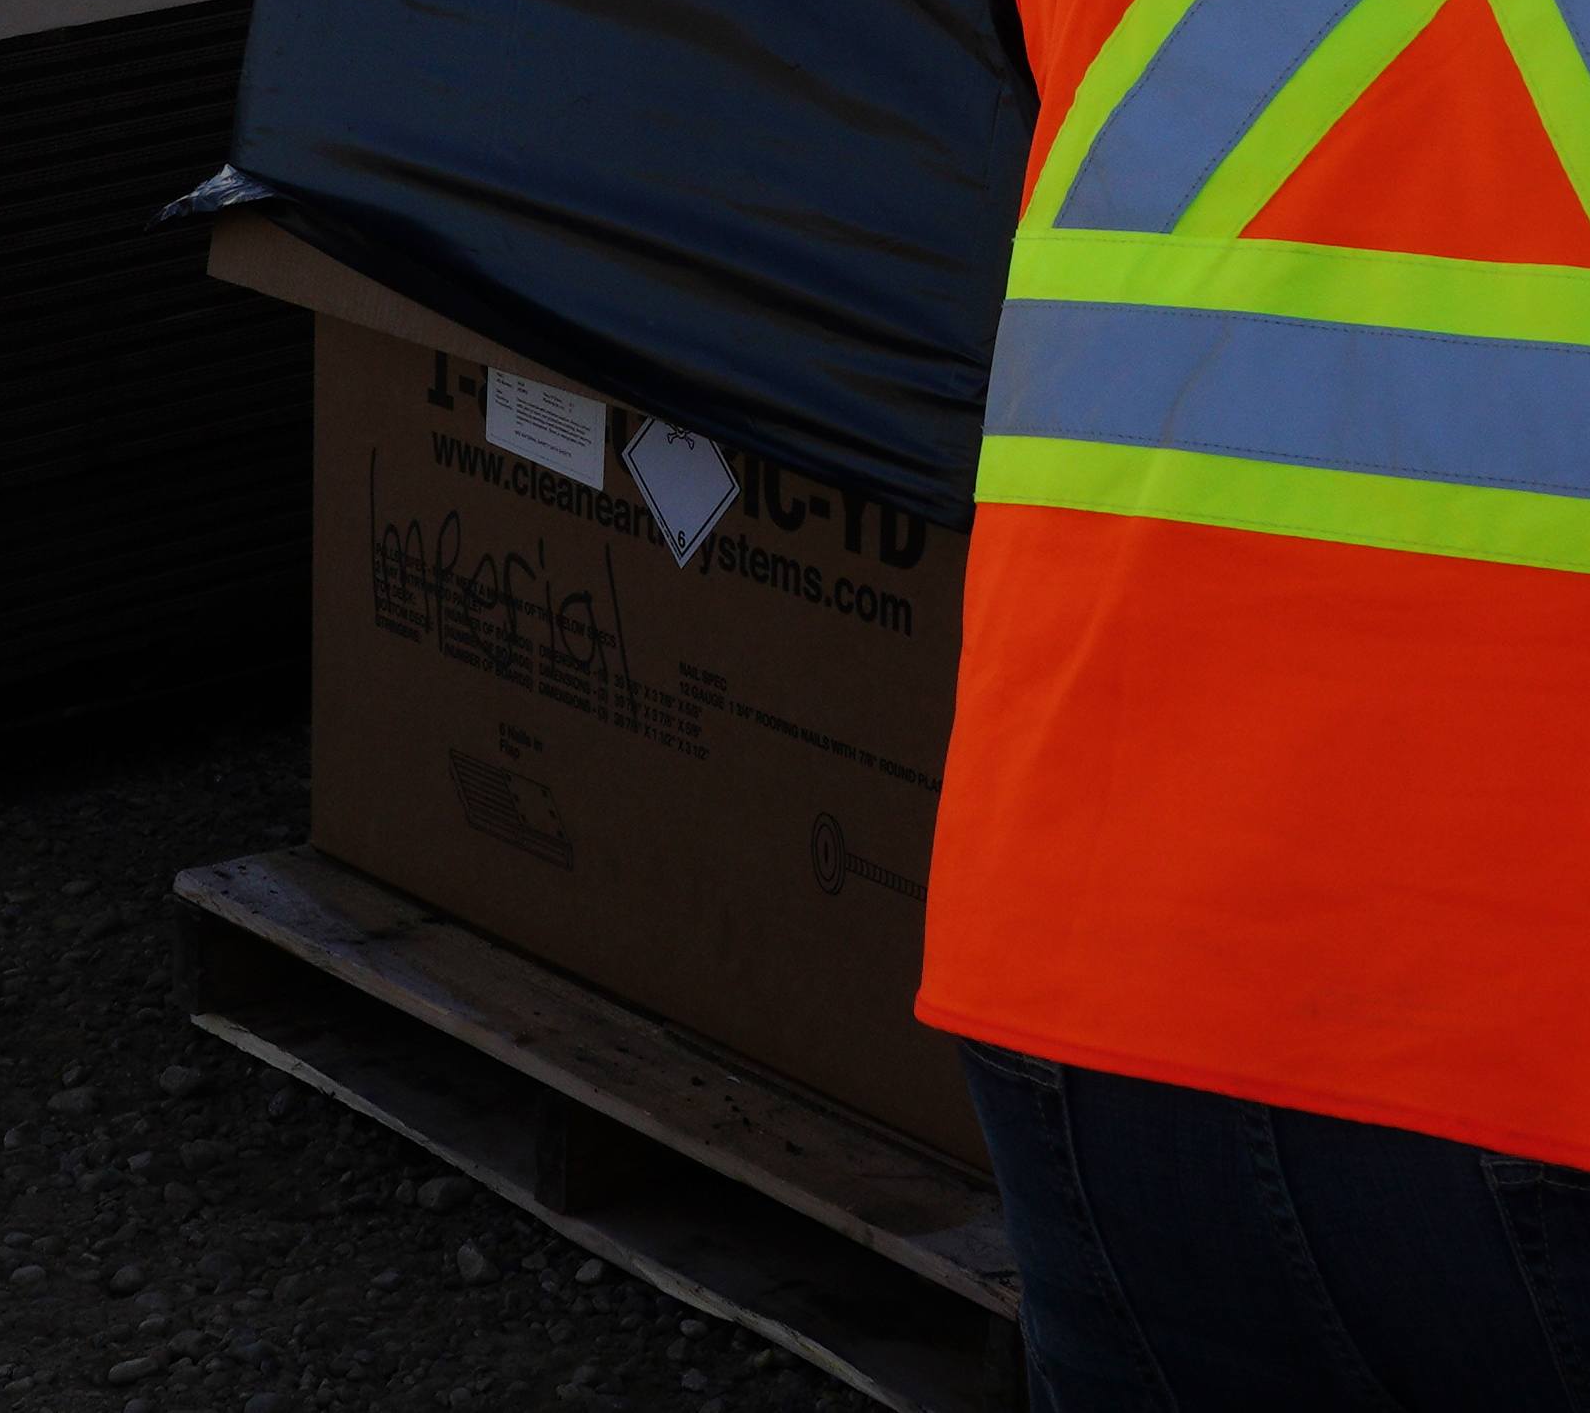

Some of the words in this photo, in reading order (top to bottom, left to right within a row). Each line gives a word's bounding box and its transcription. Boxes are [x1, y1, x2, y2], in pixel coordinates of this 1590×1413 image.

[677, 530, 686, 549] 6
[444, 644, 480, 671] (NUMBER
[539, 679, 590, 712] DIMENSIONS
[679, 662, 699, 681] NAIL
[701, 671, 727, 691] SPEC
[680, 682, 691, 696] 12
[692, 687, 724, 710] GAUGE
[755, 711, 799, 738] ROOFING
[800, 728, 829, 751] NAILS
[831, 740, 856, 761] WITH
[879, 758, 916, 784] ROUND
